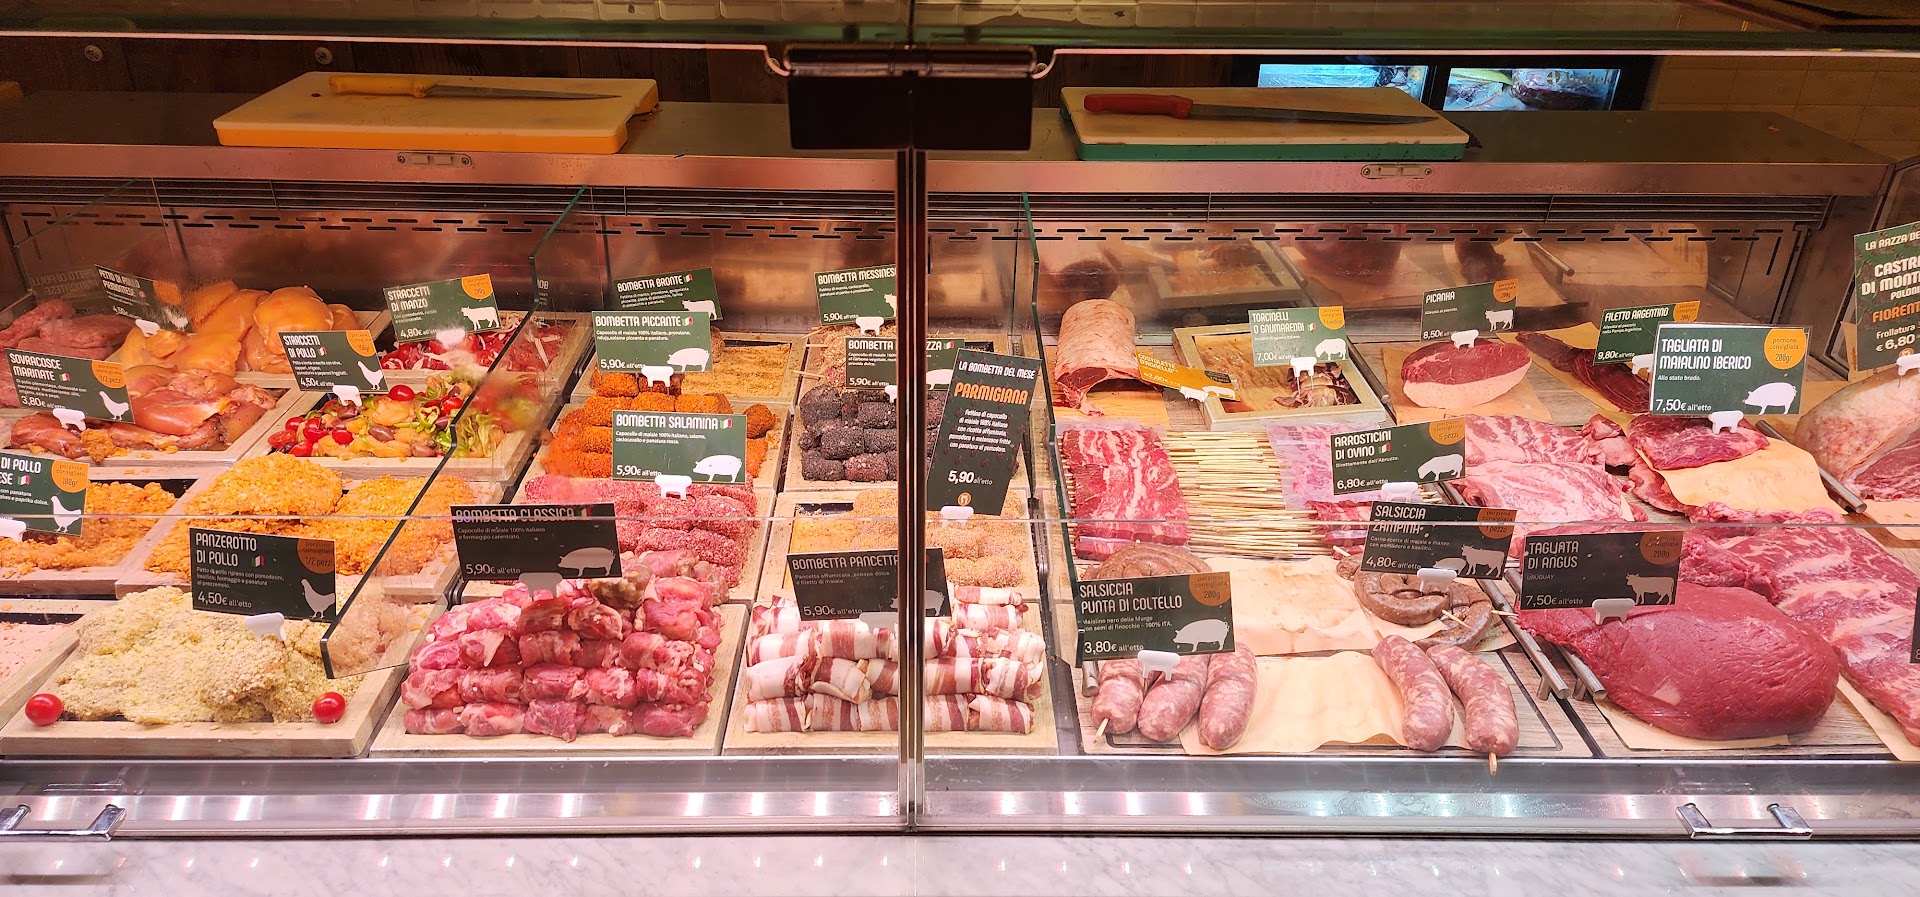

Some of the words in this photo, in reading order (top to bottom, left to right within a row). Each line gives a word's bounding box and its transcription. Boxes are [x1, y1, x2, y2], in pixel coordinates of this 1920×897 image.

[1866, 241, 1876, 251] LA
[1879, 234, 1907, 248] RAZZA
[818, 272, 857, 285] BOMBETTA
[859, 268, 897, 281] MESSINES
[618, 279, 655, 293] BOMBETTA
[656, 275, 684, 288] BRONTE
[1862, 281, 1875, 295] DI
[387, 286, 431, 301] STRACCETTI
[1426, 291, 1455, 304] PICANHA
[391, 302, 399, 312] DI
[401, 299, 429, 311] MANZO
[595, 316, 640, 327] BOMBETTA
[642, 316, 681, 327] PICCANTE
[824, 313, 843, 322] 5,90€
[1252, 311, 1289, 323] TORCINELLI
[1605, 310, 1631, 322] FILETTO
[1632, 307, 1669, 320] ARGENTINO
[400, 328, 423, 339] 4,80€
[1253, 325, 1259, 334] O
[1260, 322, 1305, 333] GNUMAREDDI
[1423, 330, 1443, 340] 8,50€
[1877, 325, 1916, 339] Frollatura
[283, 335, 321, 346] STRACCETTI
[848, 340, 894, 350] BOMBETTA
[1661, 339, 1710, 353] TAGLIATA
[1712, 339, 1723, 353] DI
[1885, 334, 1915, 350] 6,80
[288, 348, 295, 358] DI
[296, 348, 317, 358] POLLO
[1257, 352, 1278, 362] 7,00€
[1598, 350, 1619, 361] 9,80€
[9, 353, 62, 370] SOVRACOSCE
[601, 359, 626, 370] 5,90€
[1659, 356, 1711, 370] MAIALINO
[1713, 356, 1752, 370] IBERICO
[13, 366, 56, 382] MARINATE
[959, 360, 967, 371] LA
[968, 361, 1004, 377] BOMBETTA
[1004, 366, 1016, 378] DEL
[1017, 368, 1036, 380] MESE
[301, 377, 319, 388] 4,50€
[849, 378, 871, 386] 5,90€
[954, 382, 1029, 405] PARMIGIANA
[21, 395, 46, 408] 3,80€
[1656, 399, 1687, 413] 7,50€
[1687, 403, 1712, 411] all'etto
[616, 414, 666, 428] BOMBETTA
[669, 416, 719, 430] SALAMINA
[1335, 430, 1392, 448] ARROSTICINI
[1336, 449, 1345, 460] DI
[1347, 445, 1375, 459] OVINO
[1, 457, 10, 469] DI
[13, 459, 41, 474] POLLO
[616, 465, 642, 477] 5,90€
[1336, 460, 1367, 468] Direttamente
[948, 470, 975, 485] 5,90
[1337, 478, 1366, 490] 6,80€
[1375, 505, 1427, 520] SALSICCIA
[196, 532, 257, 552] PANZEROTTO
[1529, 541, 1579, 555] TAGLIATA
[196, 550, 206, 564] DI
[209, 551, 239, 567] POLLO
[792, 558, 847, 571] BOMBETTA
[850, 555, 899, 569] PANCETTA
[1366, 556, 1398, 568] 4,80€
[1397, 562, 1422, 570] all'etto
[1528, 557, 1538, 570] DI
[1542, 555, 1578, 569] ANGUS
[466, 563, 496, 576] 5,90€
[1080, 582, 1134, 598] SALSICCIA
[198, 591, 228, 606] 4,50€
[228, 599, 252, 608] all'etto
[1082, 600, 1116, 614] PUNTA
[1119, 598, 1130, 612] DI
[1133, 595, 1183, 611] COLTELLO
[1526, 594, 1557, 608] 7,50€
[804, 606, 836, 617] 5,90€
[1084, 641, 1118, 654] 3,80€
[1119, 644, 1144, 652] all'etto
